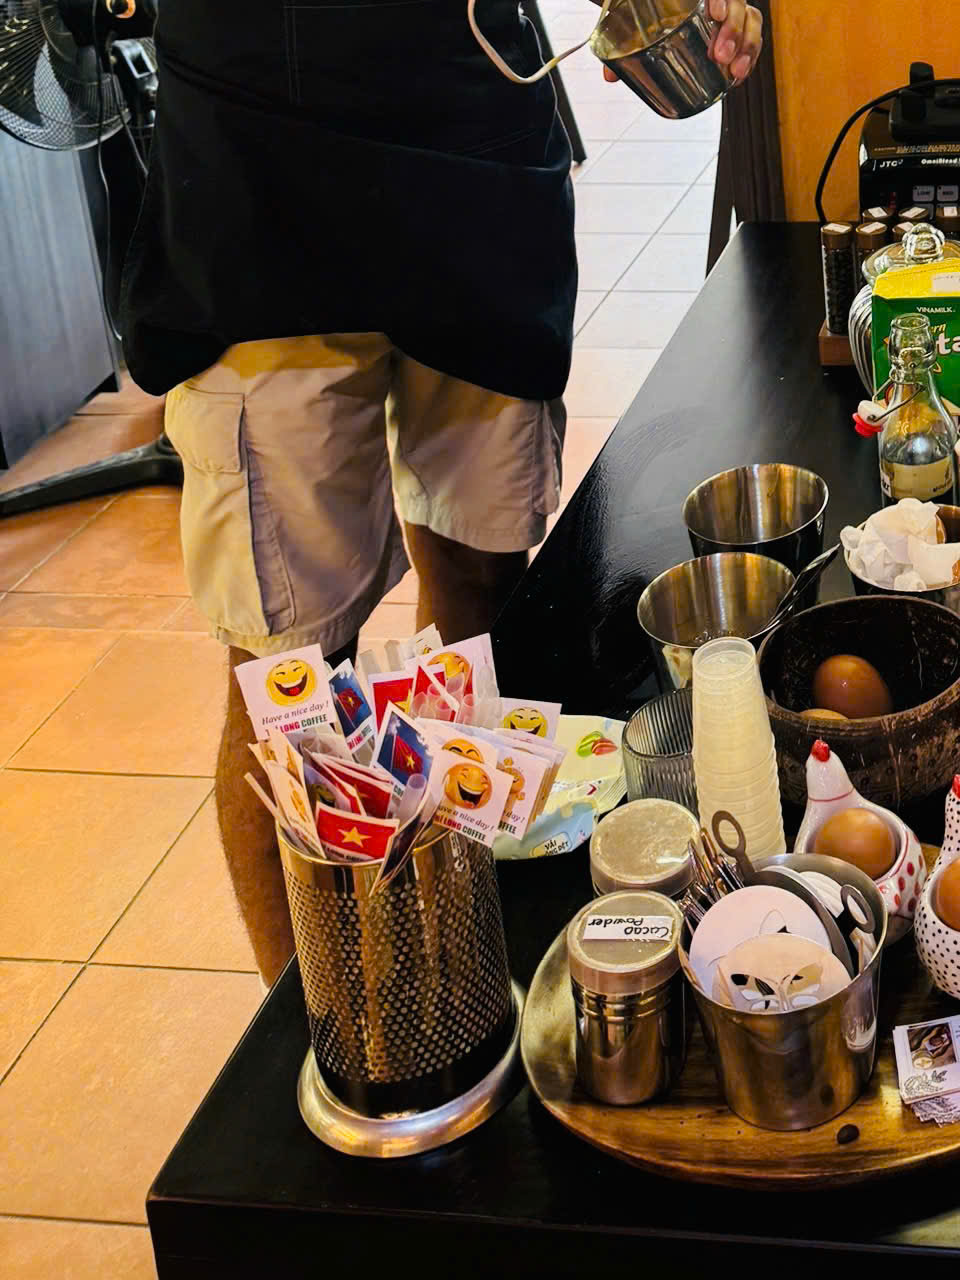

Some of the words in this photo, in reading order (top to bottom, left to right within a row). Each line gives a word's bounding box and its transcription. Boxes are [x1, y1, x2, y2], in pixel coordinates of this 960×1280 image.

[880, 159, 898, 168] JTC
[262, 712, 283, 726] Have
[284, 711, 290, 719] a
[291, 706, 308, 718] nice
[309, 702, 325, 715] day
[279, 721, 300, 734] LONG
[301, 713, 328, 729] COFFEE
[443, 815, 462, 830] LONG
[462, 824, 487, 841] COFFEE
[459, 811, 475, 824] nice
[475, 818, 489, 831] day
[588, 917, 644, 928] Powder
